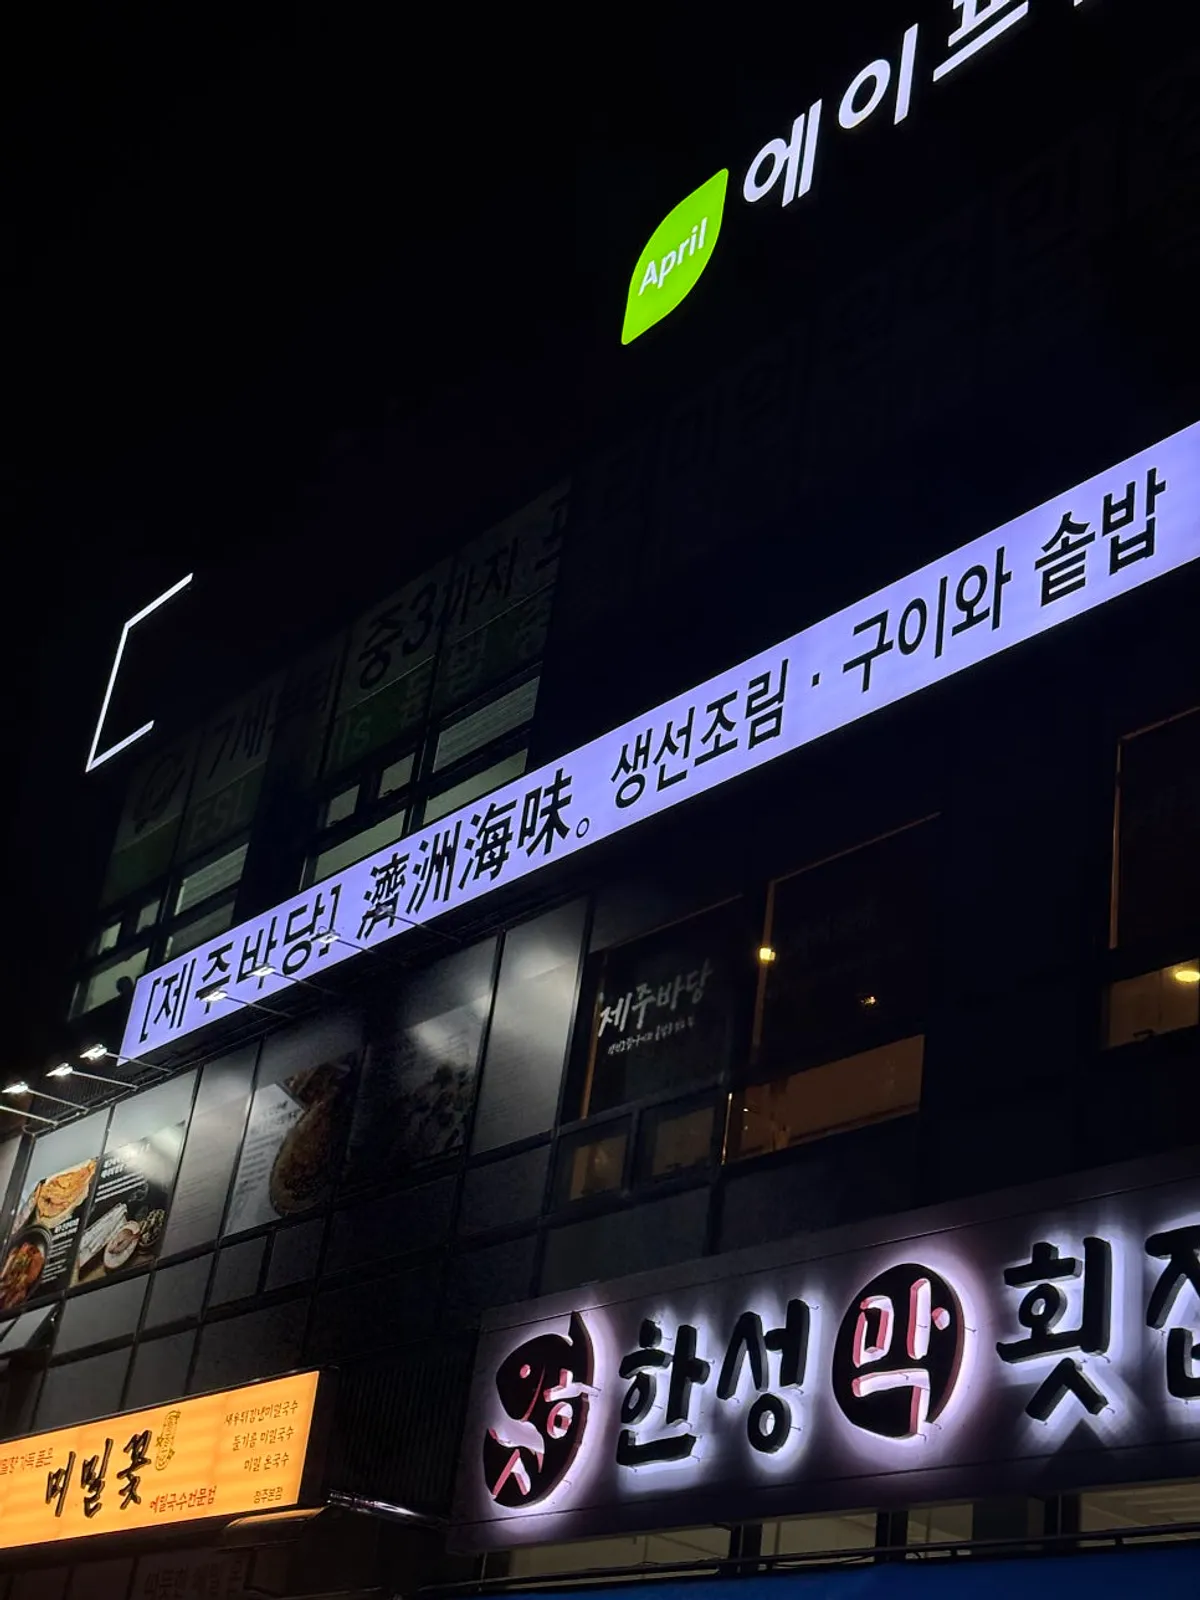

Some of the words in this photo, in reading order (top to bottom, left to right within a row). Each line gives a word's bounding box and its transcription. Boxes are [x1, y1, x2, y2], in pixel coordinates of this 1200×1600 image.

[637, 216, 708, 296] April
[610, 658, 790, 809] 생선조림
[842, 546, 1012, 693] 구이와
[1034, 467, 1167, 608] 솥밥
[598, 956, 716, 1038] 제주바당
[45, 1429, 152, 1518] 메밀꽃
